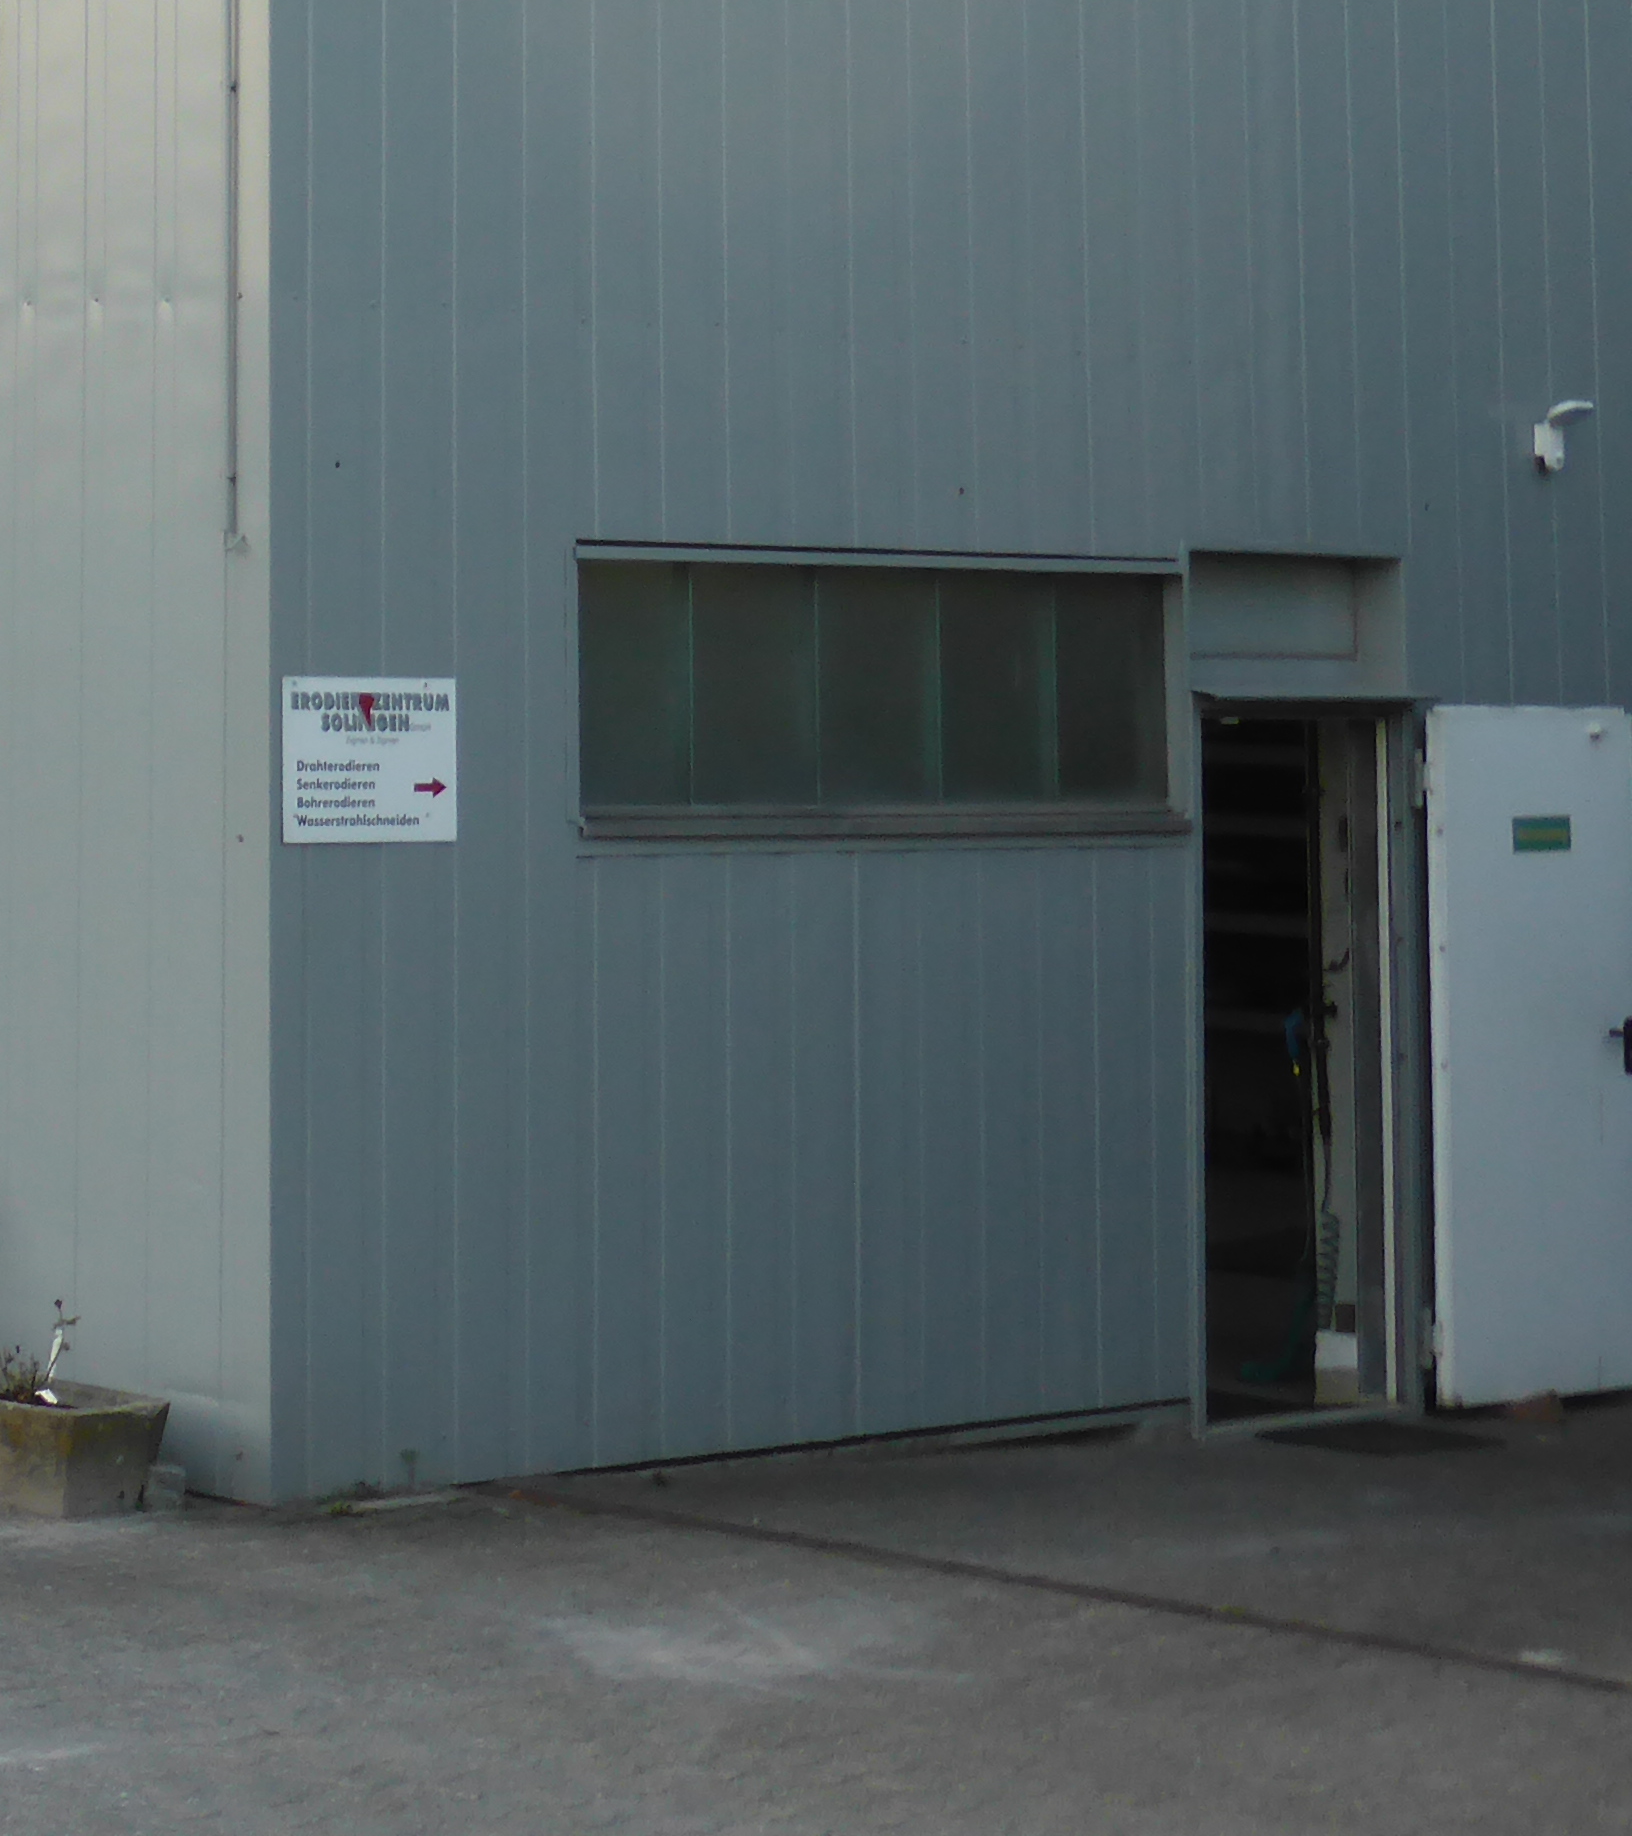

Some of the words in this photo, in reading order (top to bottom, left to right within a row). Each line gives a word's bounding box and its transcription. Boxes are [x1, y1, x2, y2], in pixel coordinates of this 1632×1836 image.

[373, 692, 450, 712] ZENTRUM
[296, 761, 380, 772] Drahterodieren
[296, 778, 375, 790] Senkerodieren
[296, 797, 375, 809] Bohrerodieren
[296, 814, 420, 826] Wasserstrahlschneiden
